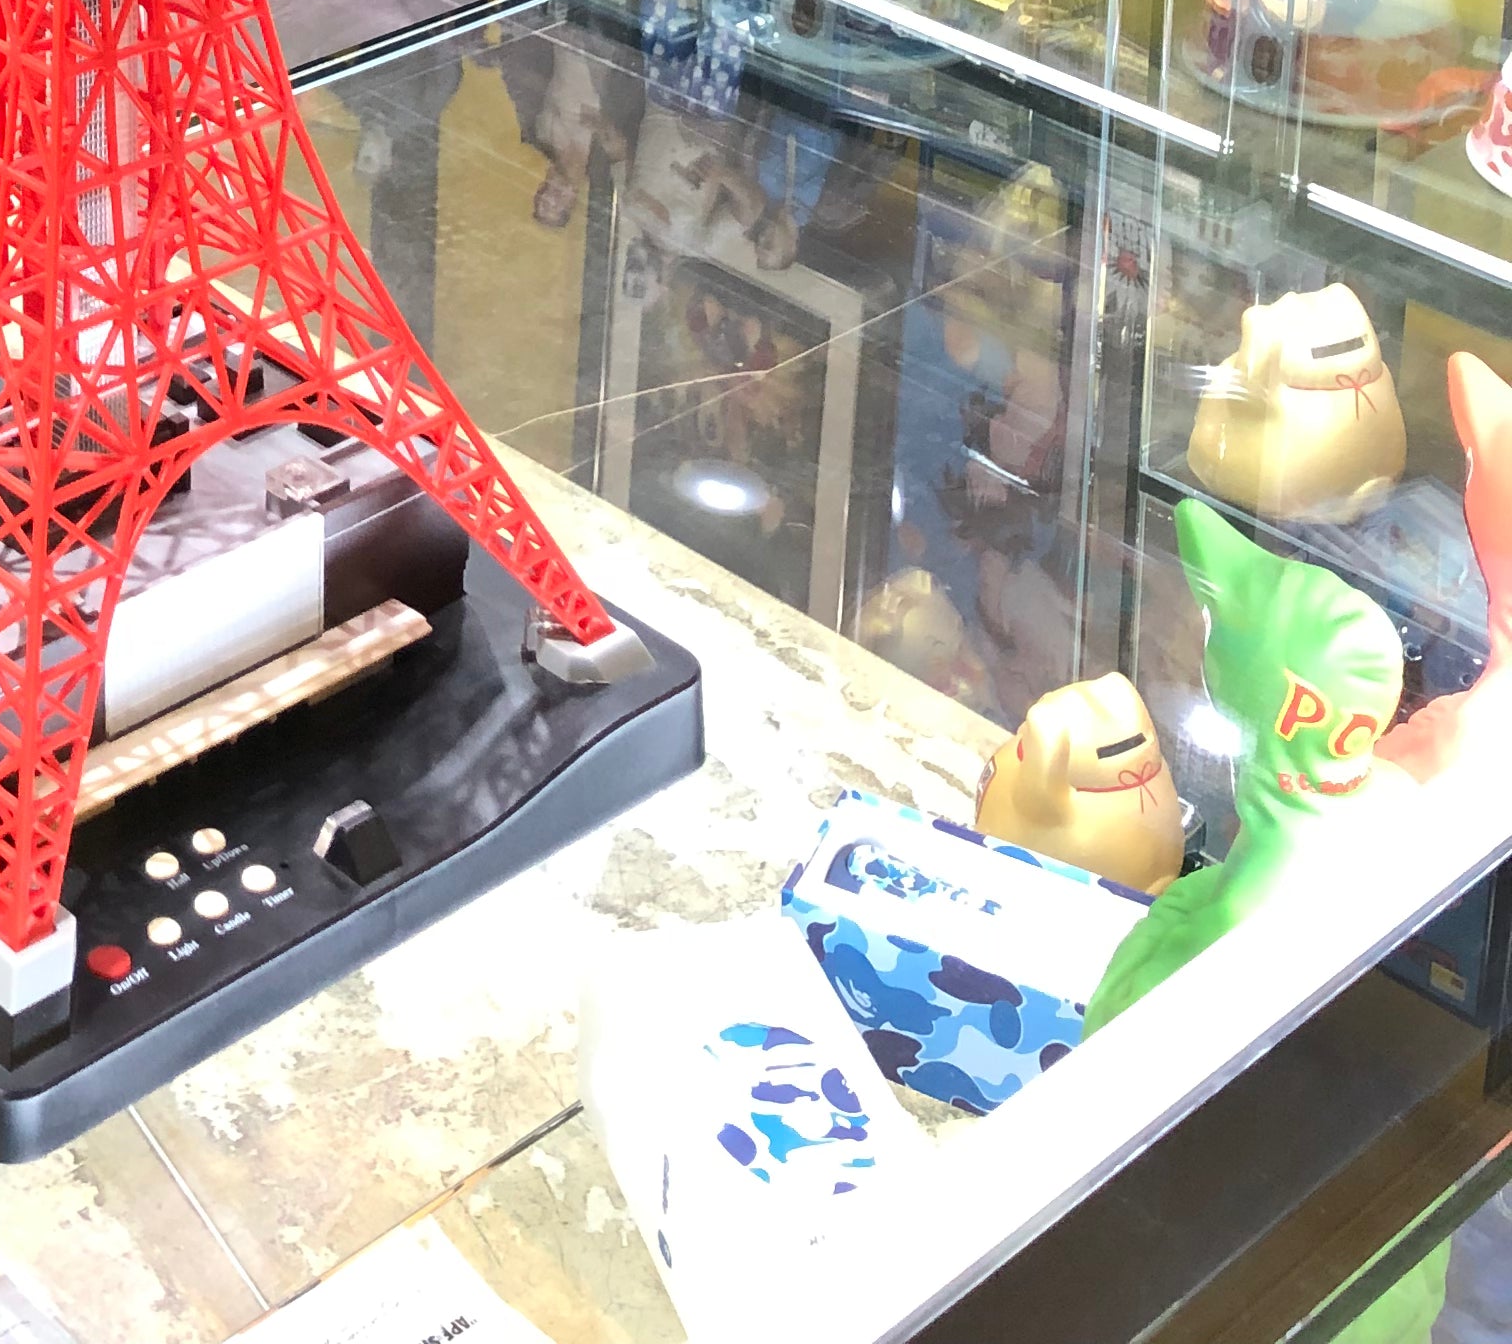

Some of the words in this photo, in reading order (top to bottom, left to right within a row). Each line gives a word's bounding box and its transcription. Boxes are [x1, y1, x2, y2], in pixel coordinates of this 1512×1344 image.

[202, 843, 250, 872] Up/Down
[261, 886, 295, 908] Timer
[214, 911, 252, 935] Candle
[167, 939, 200, 962] Light
[109, 966, 150, 996] On/Off
